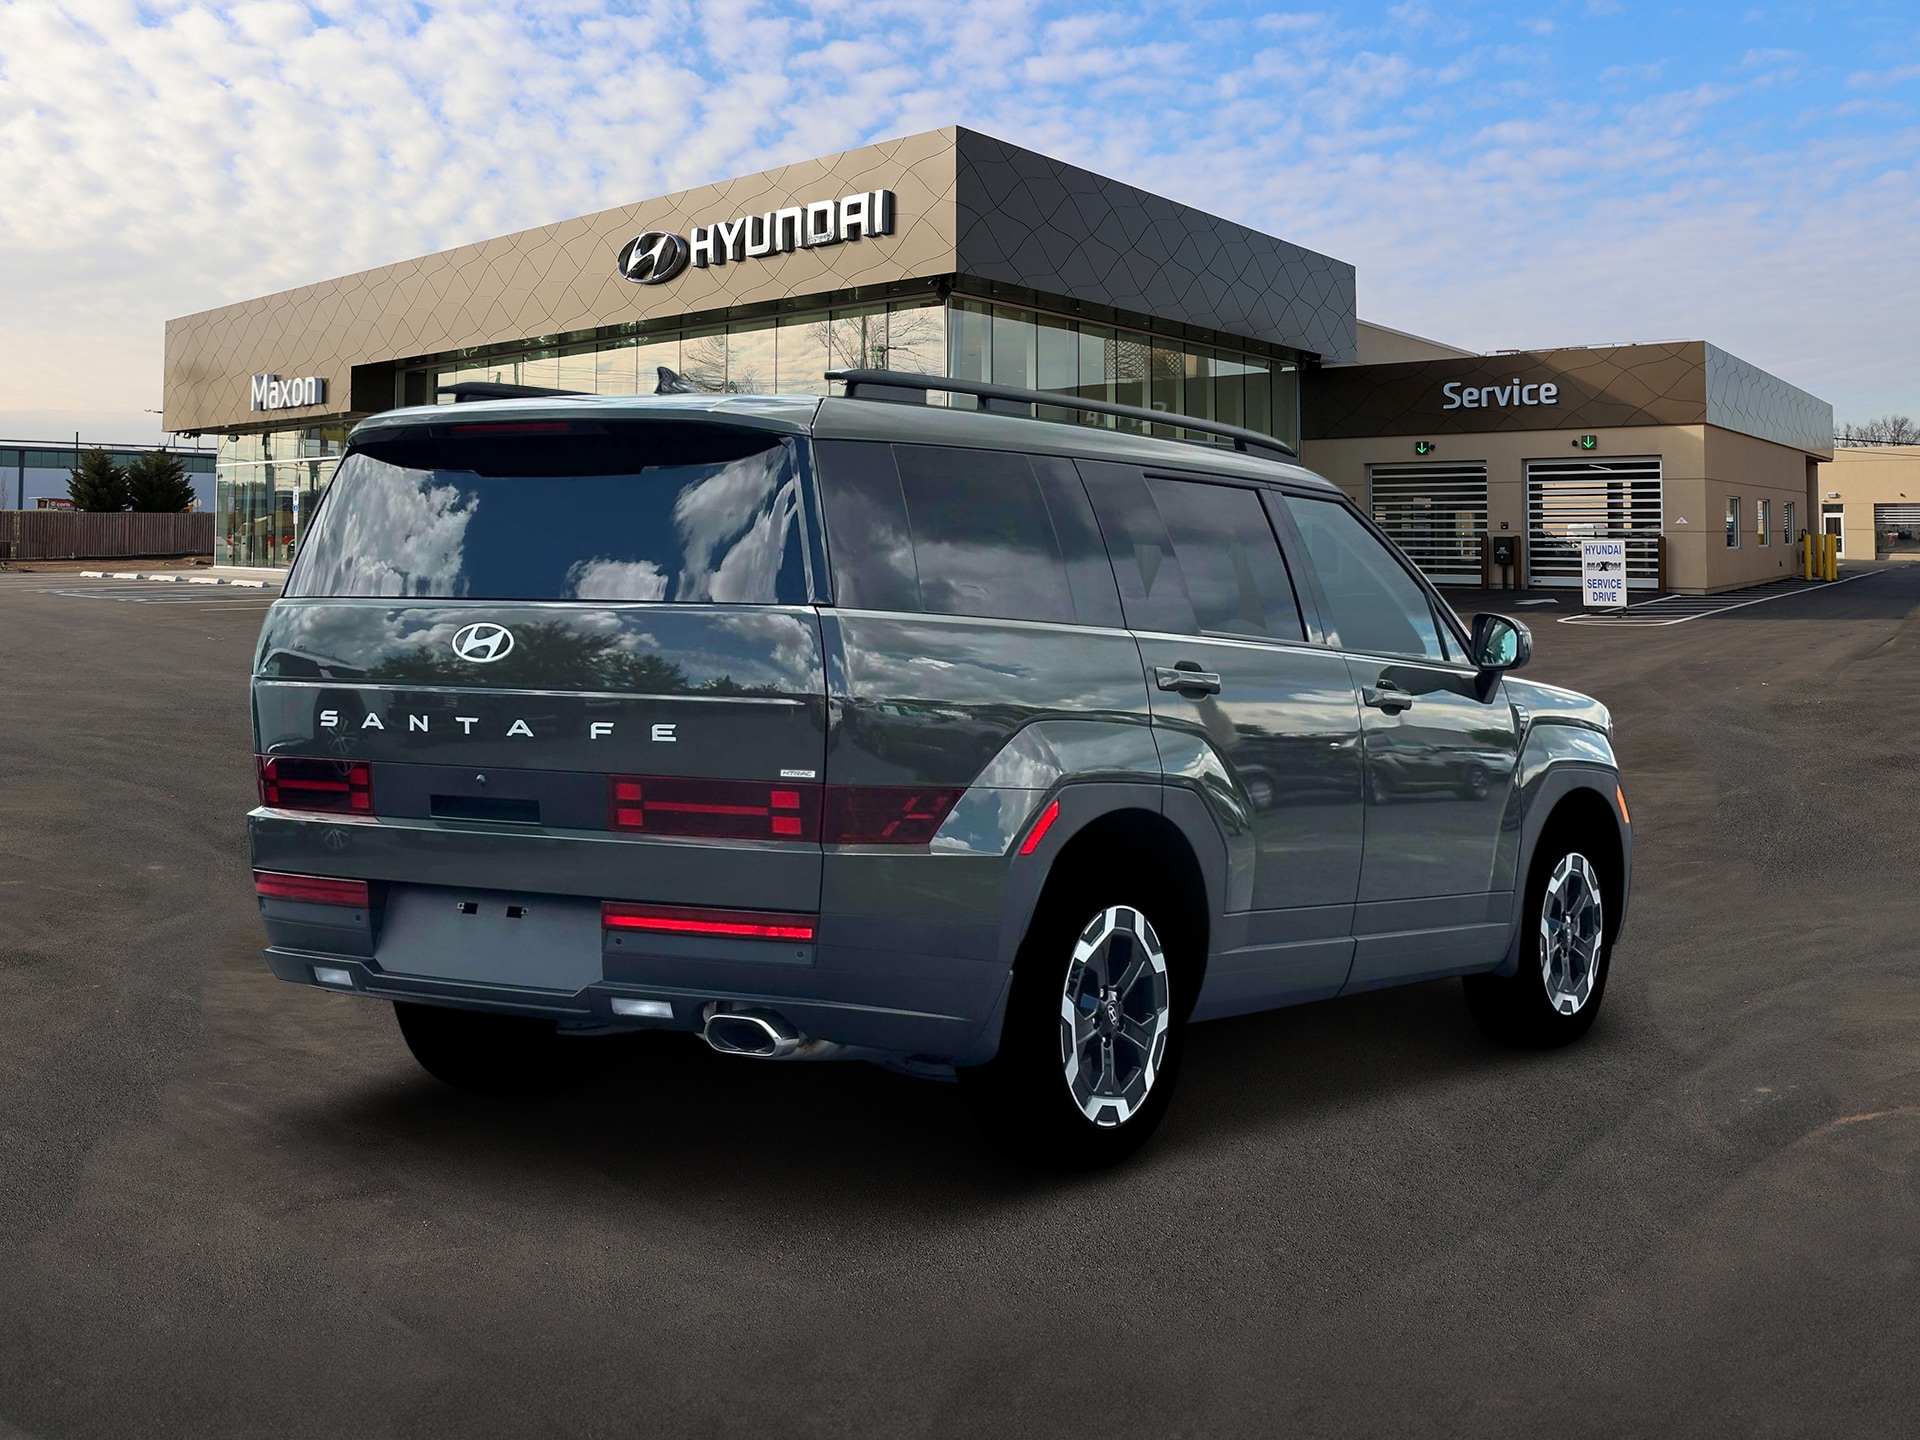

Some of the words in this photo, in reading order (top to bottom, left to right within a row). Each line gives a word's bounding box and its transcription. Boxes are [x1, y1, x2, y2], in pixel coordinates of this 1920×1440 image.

[690, 188, 895, 268] HYUNDAI
[250, 373, 324, 411] Maxon
[1442, 377, 1559, 410] Service
[1585, 544, 1622, 555] HYUNDAI
[1586, 561, 1622, 572] MAXON
[1587, 578, 1622, 589] SERVICE
[1592, 591, 1617, 602] DRIVE
[319, 709, 535, 738] SANTA
[589, 721, 678, 742] FE
